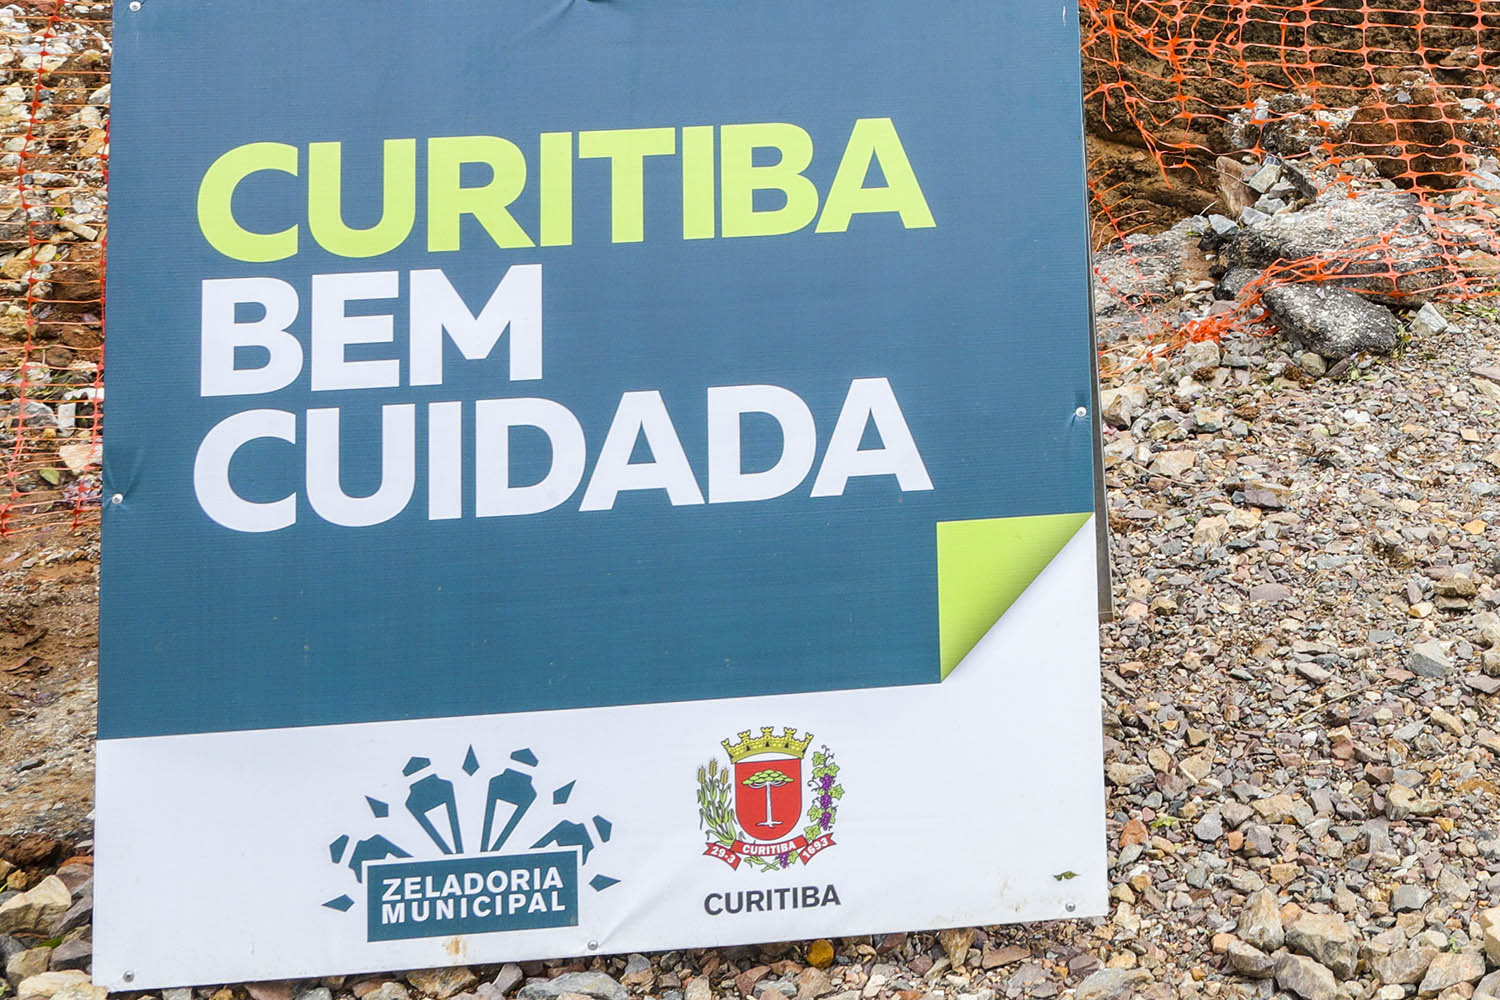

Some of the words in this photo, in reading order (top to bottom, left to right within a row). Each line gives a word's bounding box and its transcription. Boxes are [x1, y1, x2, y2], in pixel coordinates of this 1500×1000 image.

[197, 117, 937, 263] CURITIBA
[200, 264, 543, 397] BEM
[193, 377, 935, 533] CUIDADA
[742, 841, 797, 855] CURITIBA
[802, 839, 829, 859] 1693
[382, 866, 564, 901] ZELADORIA
[704, 884, 841, 916] CURITIBA
[381, 891, 566, 924] MUNICIPAL
